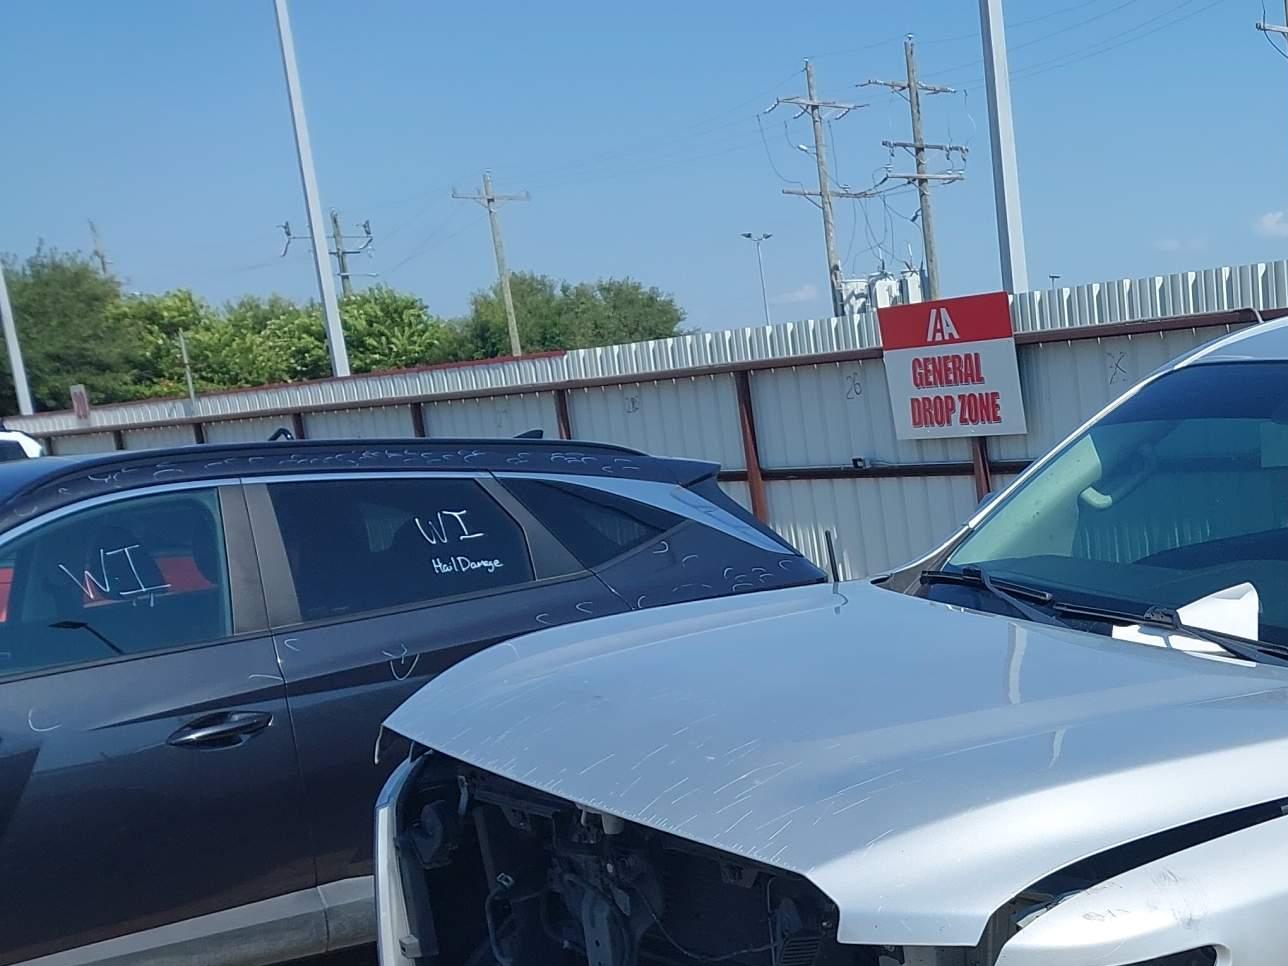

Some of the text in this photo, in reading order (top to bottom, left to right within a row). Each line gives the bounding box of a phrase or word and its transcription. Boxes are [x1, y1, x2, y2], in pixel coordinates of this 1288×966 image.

[911, 352, 985, 389] GENERAL
[910, 392, 1002, 428] DROP ZONE
[431, 556, 458, 574] Hail
